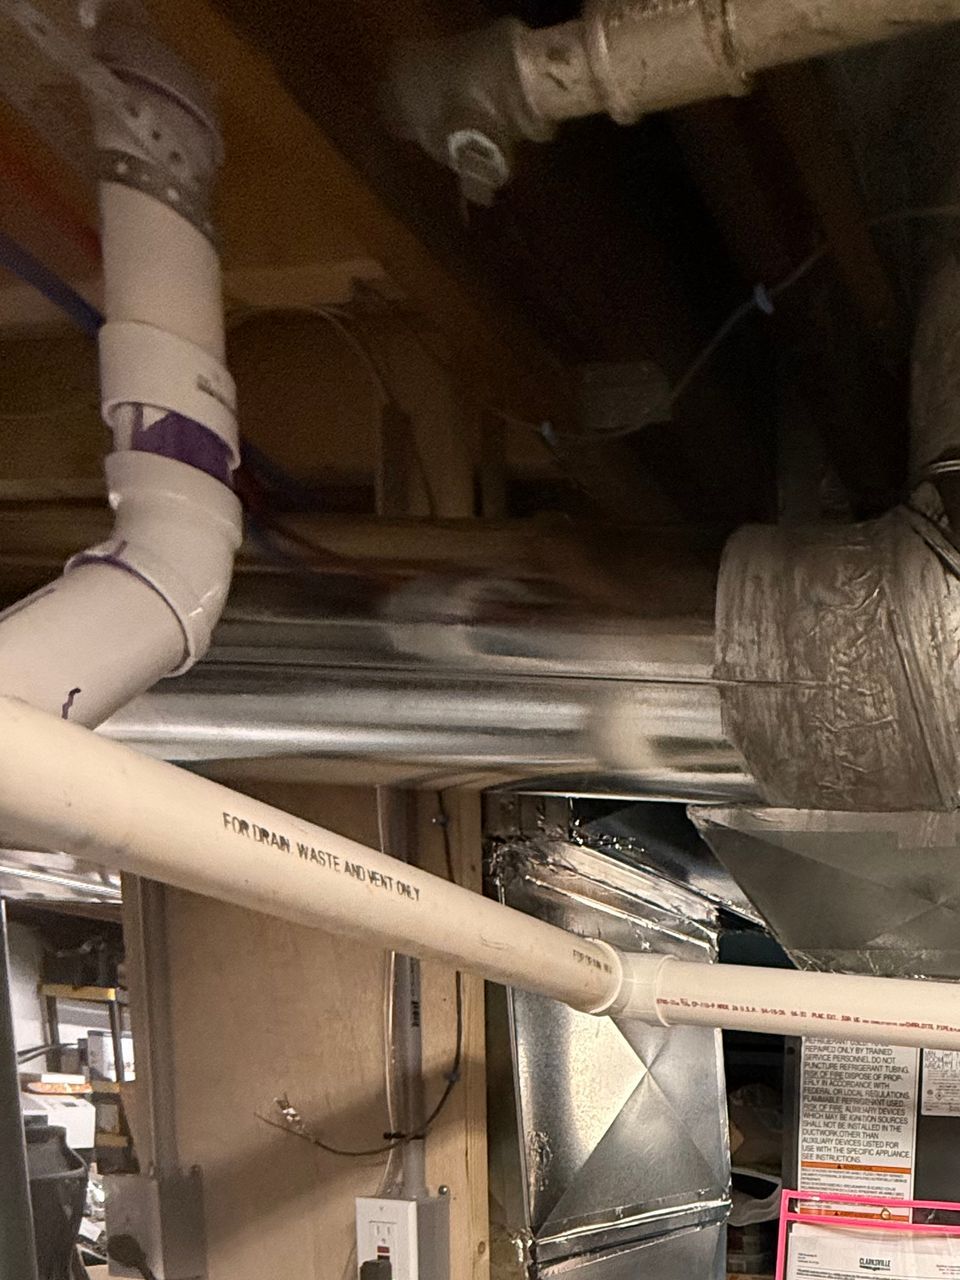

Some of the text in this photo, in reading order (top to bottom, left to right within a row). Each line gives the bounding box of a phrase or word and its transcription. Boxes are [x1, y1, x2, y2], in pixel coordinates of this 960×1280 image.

[223, 812, 250, 838] FOR
[297, 842, 340, 872] WASTE
[344, 860, 365, 881] AND
[368, 870, 393, 891] VENT
[397, 880, 420, 901] ONLY
[804, 1062, 838, 1070] PUNCTURE
[840, 1063, 883, 1072] REFRIGERANT
[844, 1072, 871, 1080] DISPOSE
[803, 1087, 832, 1095] FEDERAL
[843, 1088, 863, 1097] LOCAL
[879, 1107, 906, 1116] DEVICES
[878, 1116, 909, 1125] SOURCES
[802, 1120, 822, 1128] SHALL
[823, 1121, 836, 1129] NOT
[847, 1123, 880, 1131] INSTALLED
[890, 1125, 902, 1133] THE
[835, 1138, 861, 1146] DEVICES
[862, 1140, 884, 1148] LISTED
[885, 1141, 899, 1149] FOR
[802, 1144, 814, 1152] USE
[816, 1145, 831, 1153] WITH
[833, 1146, 845, 1154] THE
[846, 1147, 874, 1156] SPECIFIC
[859, 1257, 891, 1268] CLARKSVILLE
